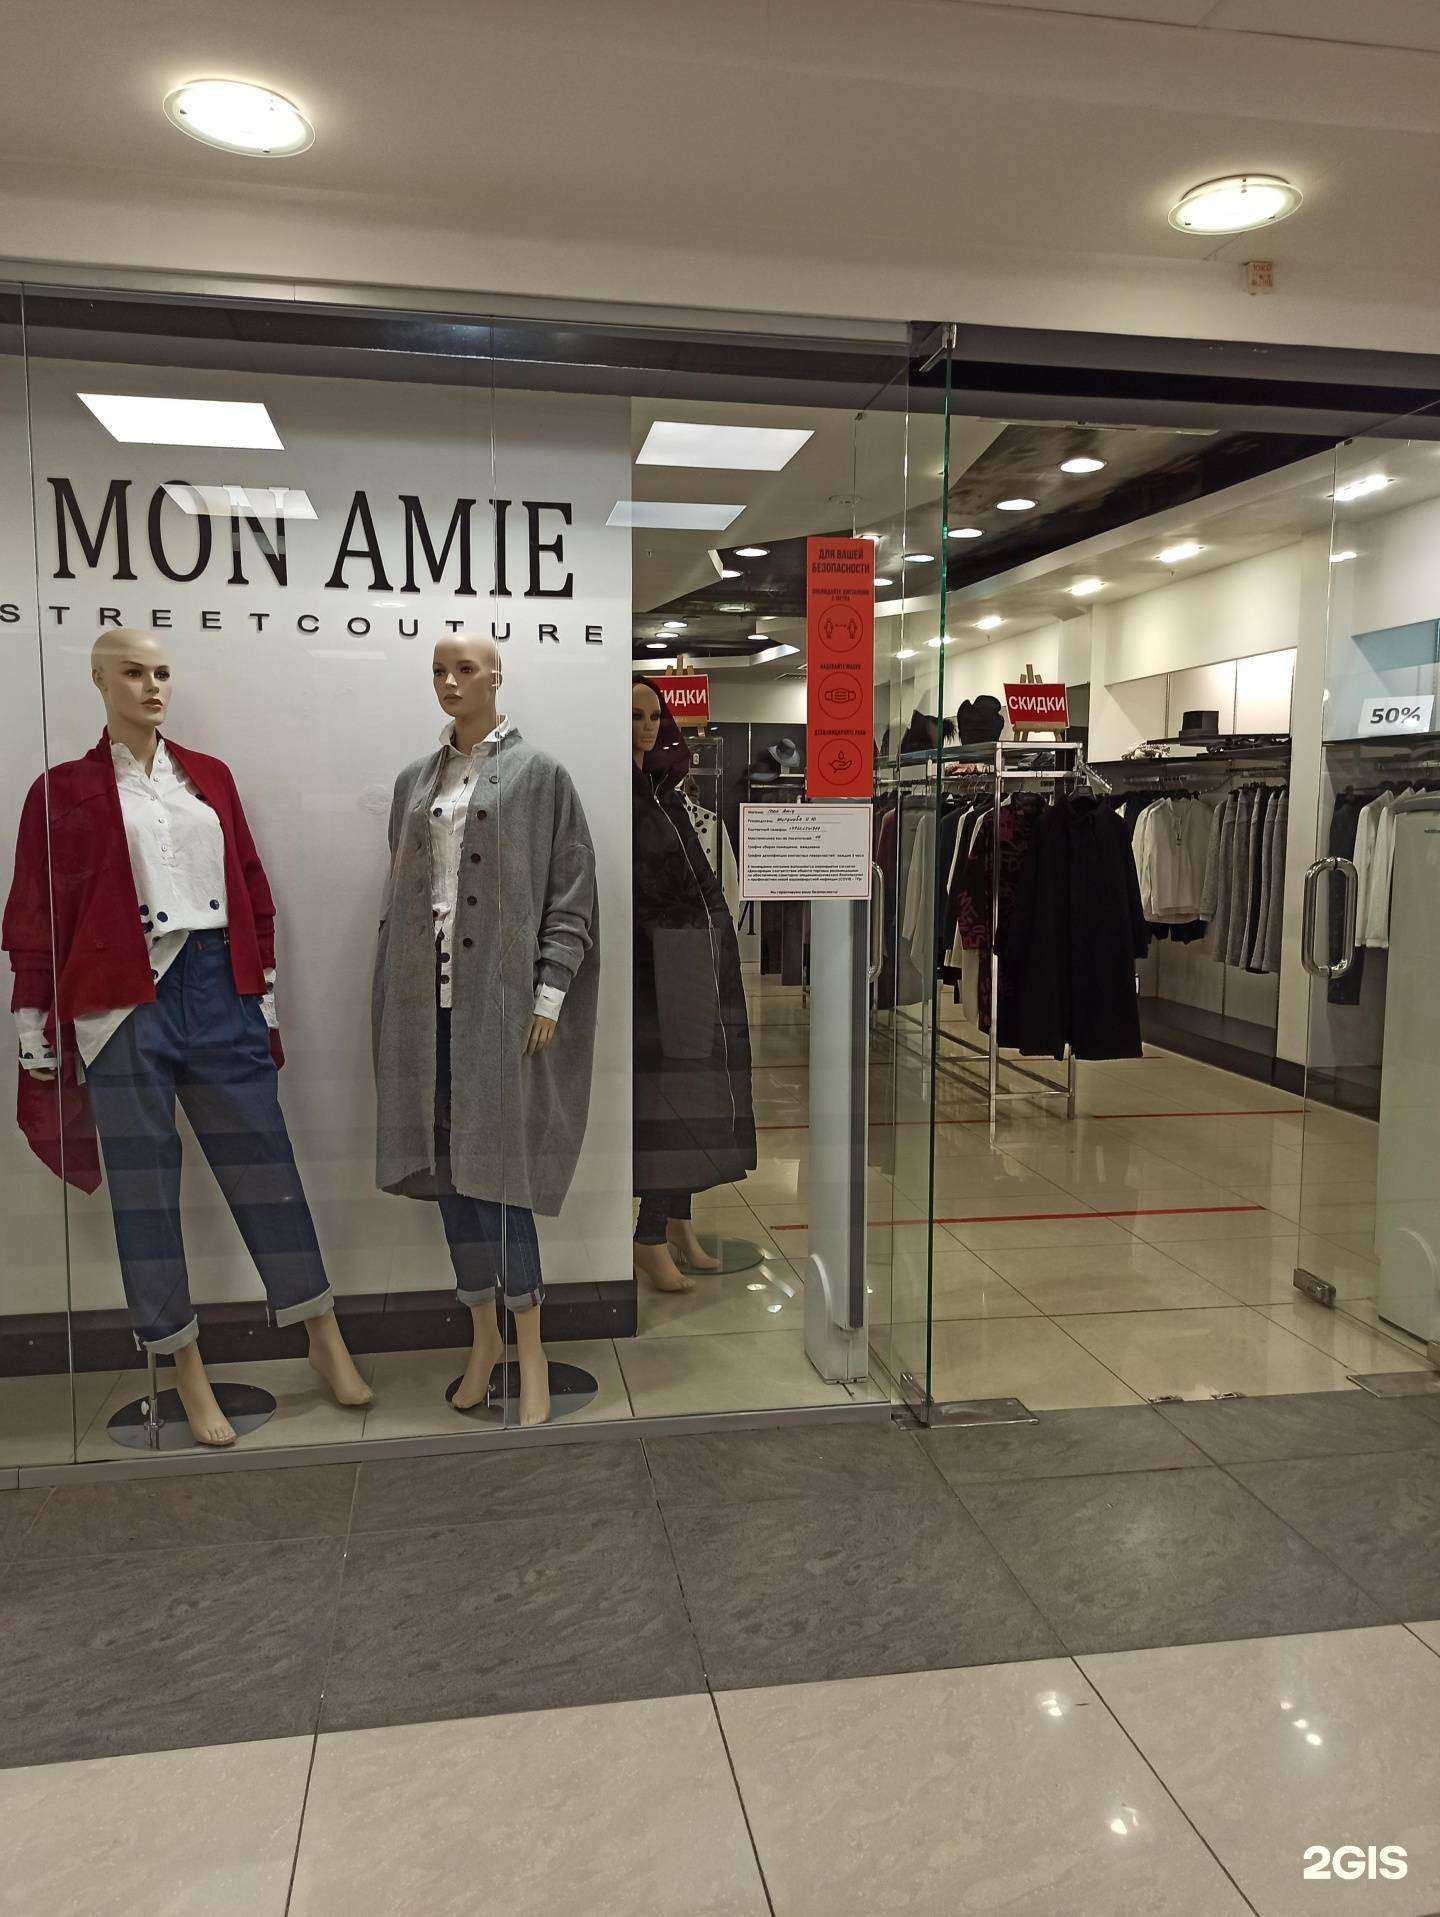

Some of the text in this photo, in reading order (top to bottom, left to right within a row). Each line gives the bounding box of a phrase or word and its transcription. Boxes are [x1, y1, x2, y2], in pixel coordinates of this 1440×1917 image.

[47, 477, 575, 599] MON AMIE
[819, 549, 864, 560] ДЛЯ ВАШЕЙ
[812, 562, 870, 574] БЕЗОПАСНОСТИ
[661, 690, 706, 707] ИДКИ
[1008, 695, 1066, 714] СКИДКИ
[1370, 706, 1421, 725] 50%
